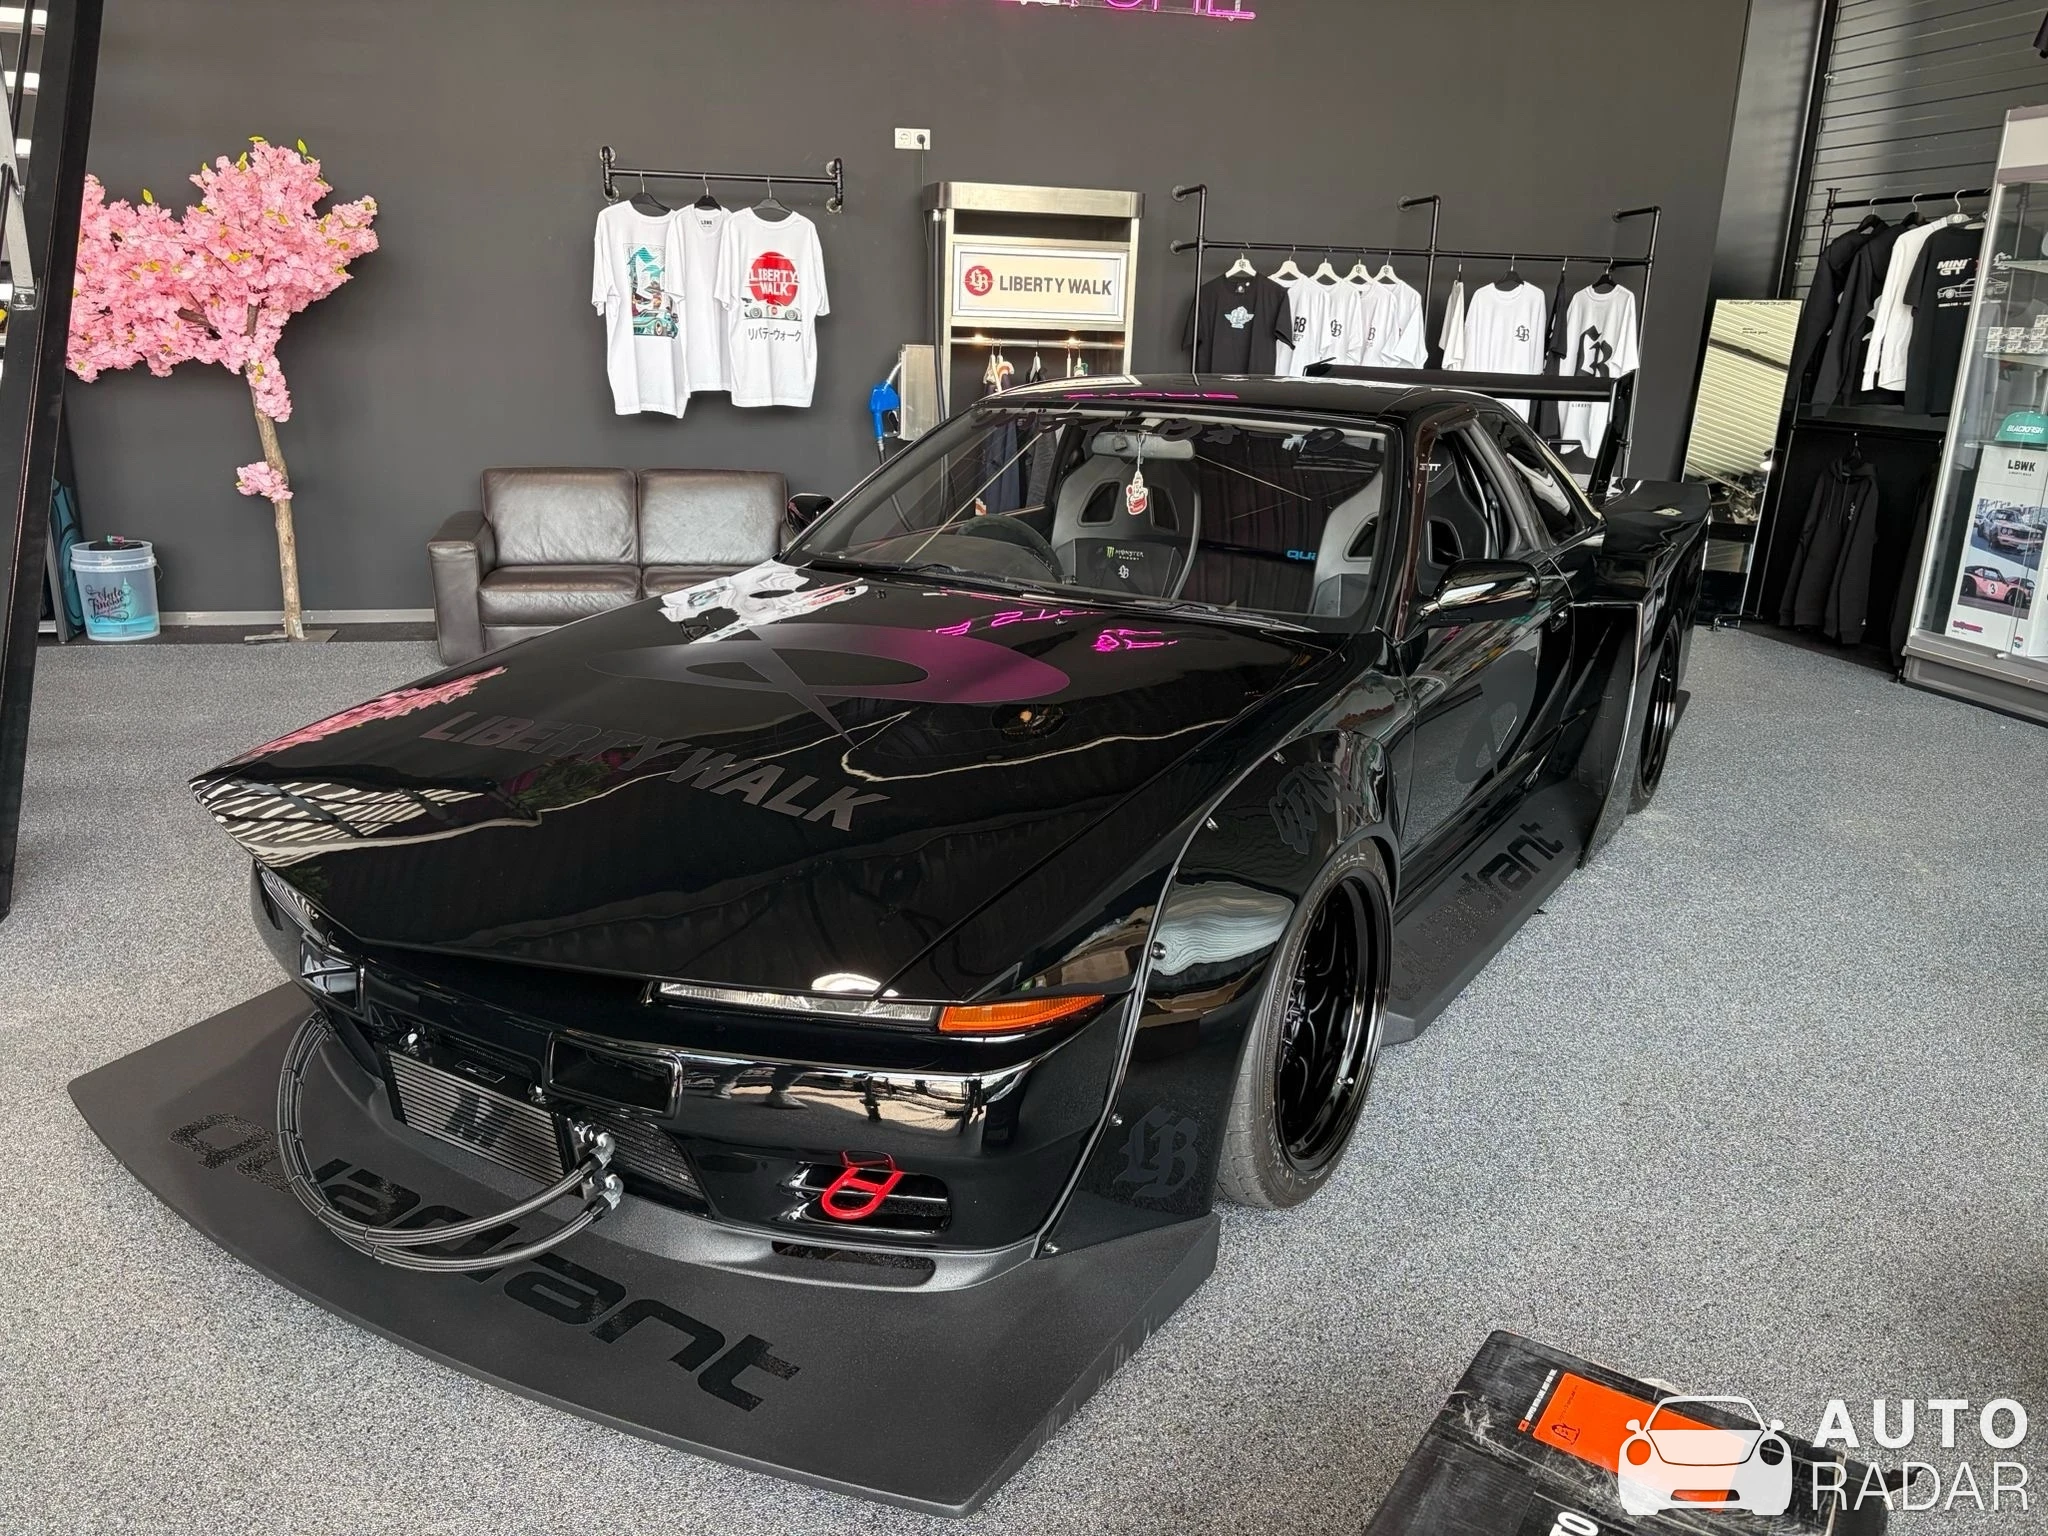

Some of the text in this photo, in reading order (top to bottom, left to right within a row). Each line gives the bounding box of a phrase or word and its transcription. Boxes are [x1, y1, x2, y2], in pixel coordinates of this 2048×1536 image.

[749, 268, 799, 283] LIBERTY
[759, 281, 789, 296] WALK
[999, 275, 1065, 293] LIBERTY
[1068, 278, 1112, 296] WALK
[2007, 460, 2036, 472] LBWK
[420, 712, 890, 831] LIBERTY WALK
